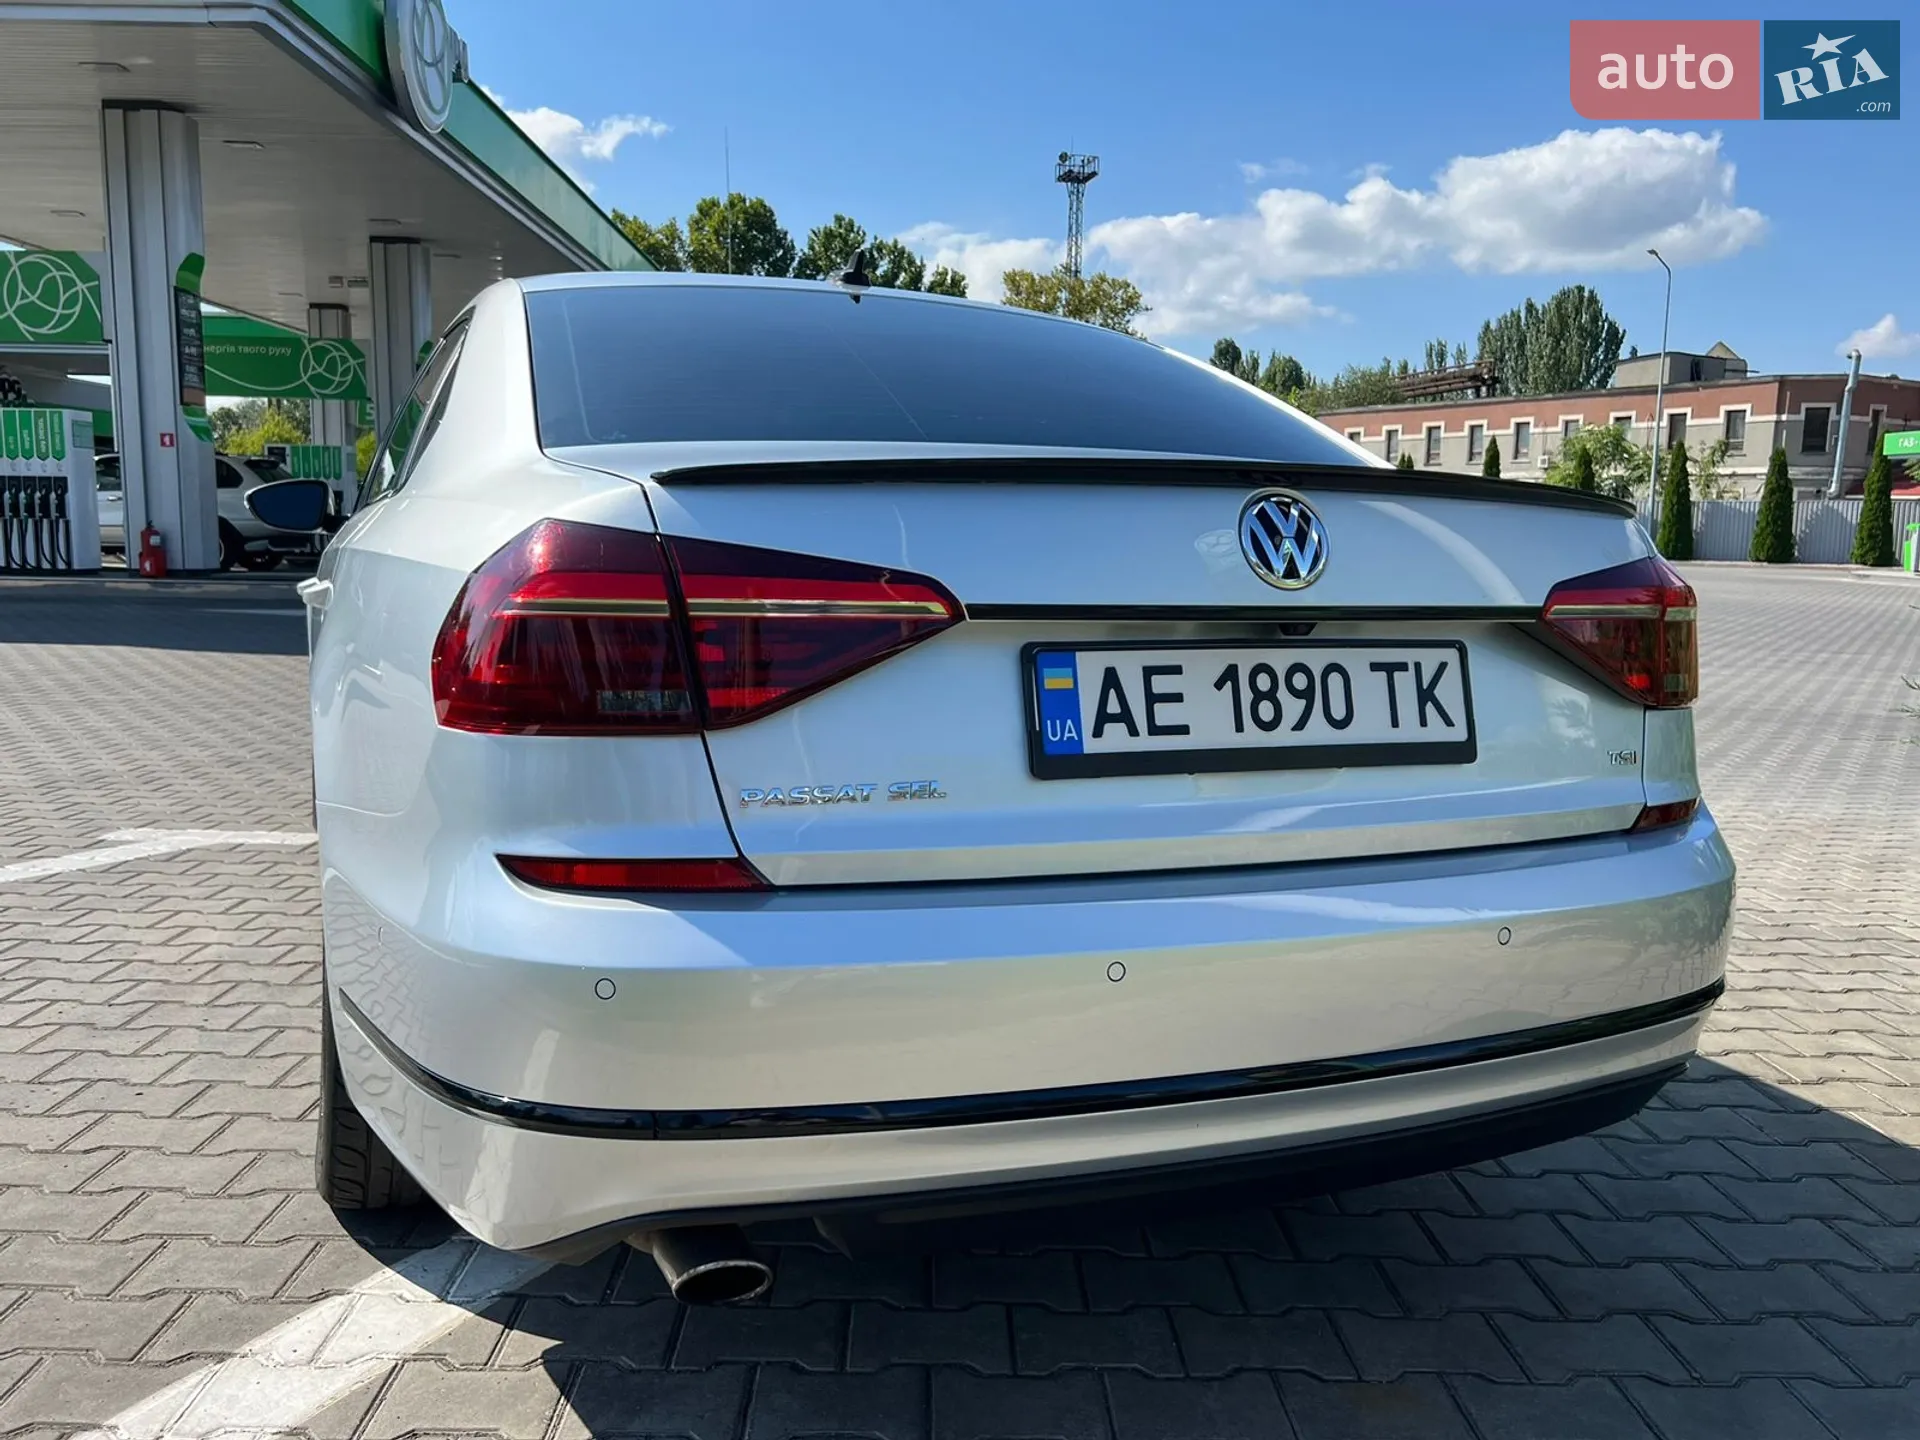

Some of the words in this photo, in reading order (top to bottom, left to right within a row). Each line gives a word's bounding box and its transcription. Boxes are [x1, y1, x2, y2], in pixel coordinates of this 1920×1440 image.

[203, 344, 236, 354] нергія
[238, 345, 267, 354] твого
[268, 346, 292, 357] руху
[1091, 664, 1191, 739] AE
[1213, 661, 1354, 734] 1890
[1369, 660, 1456, 729] TK
[1046, 718, 1079, 742] UA
[1606, 750, 1637, 766] TSI
[739, 783, 878, 808] PASSAT
[887, 779, 947, 802] SEL
